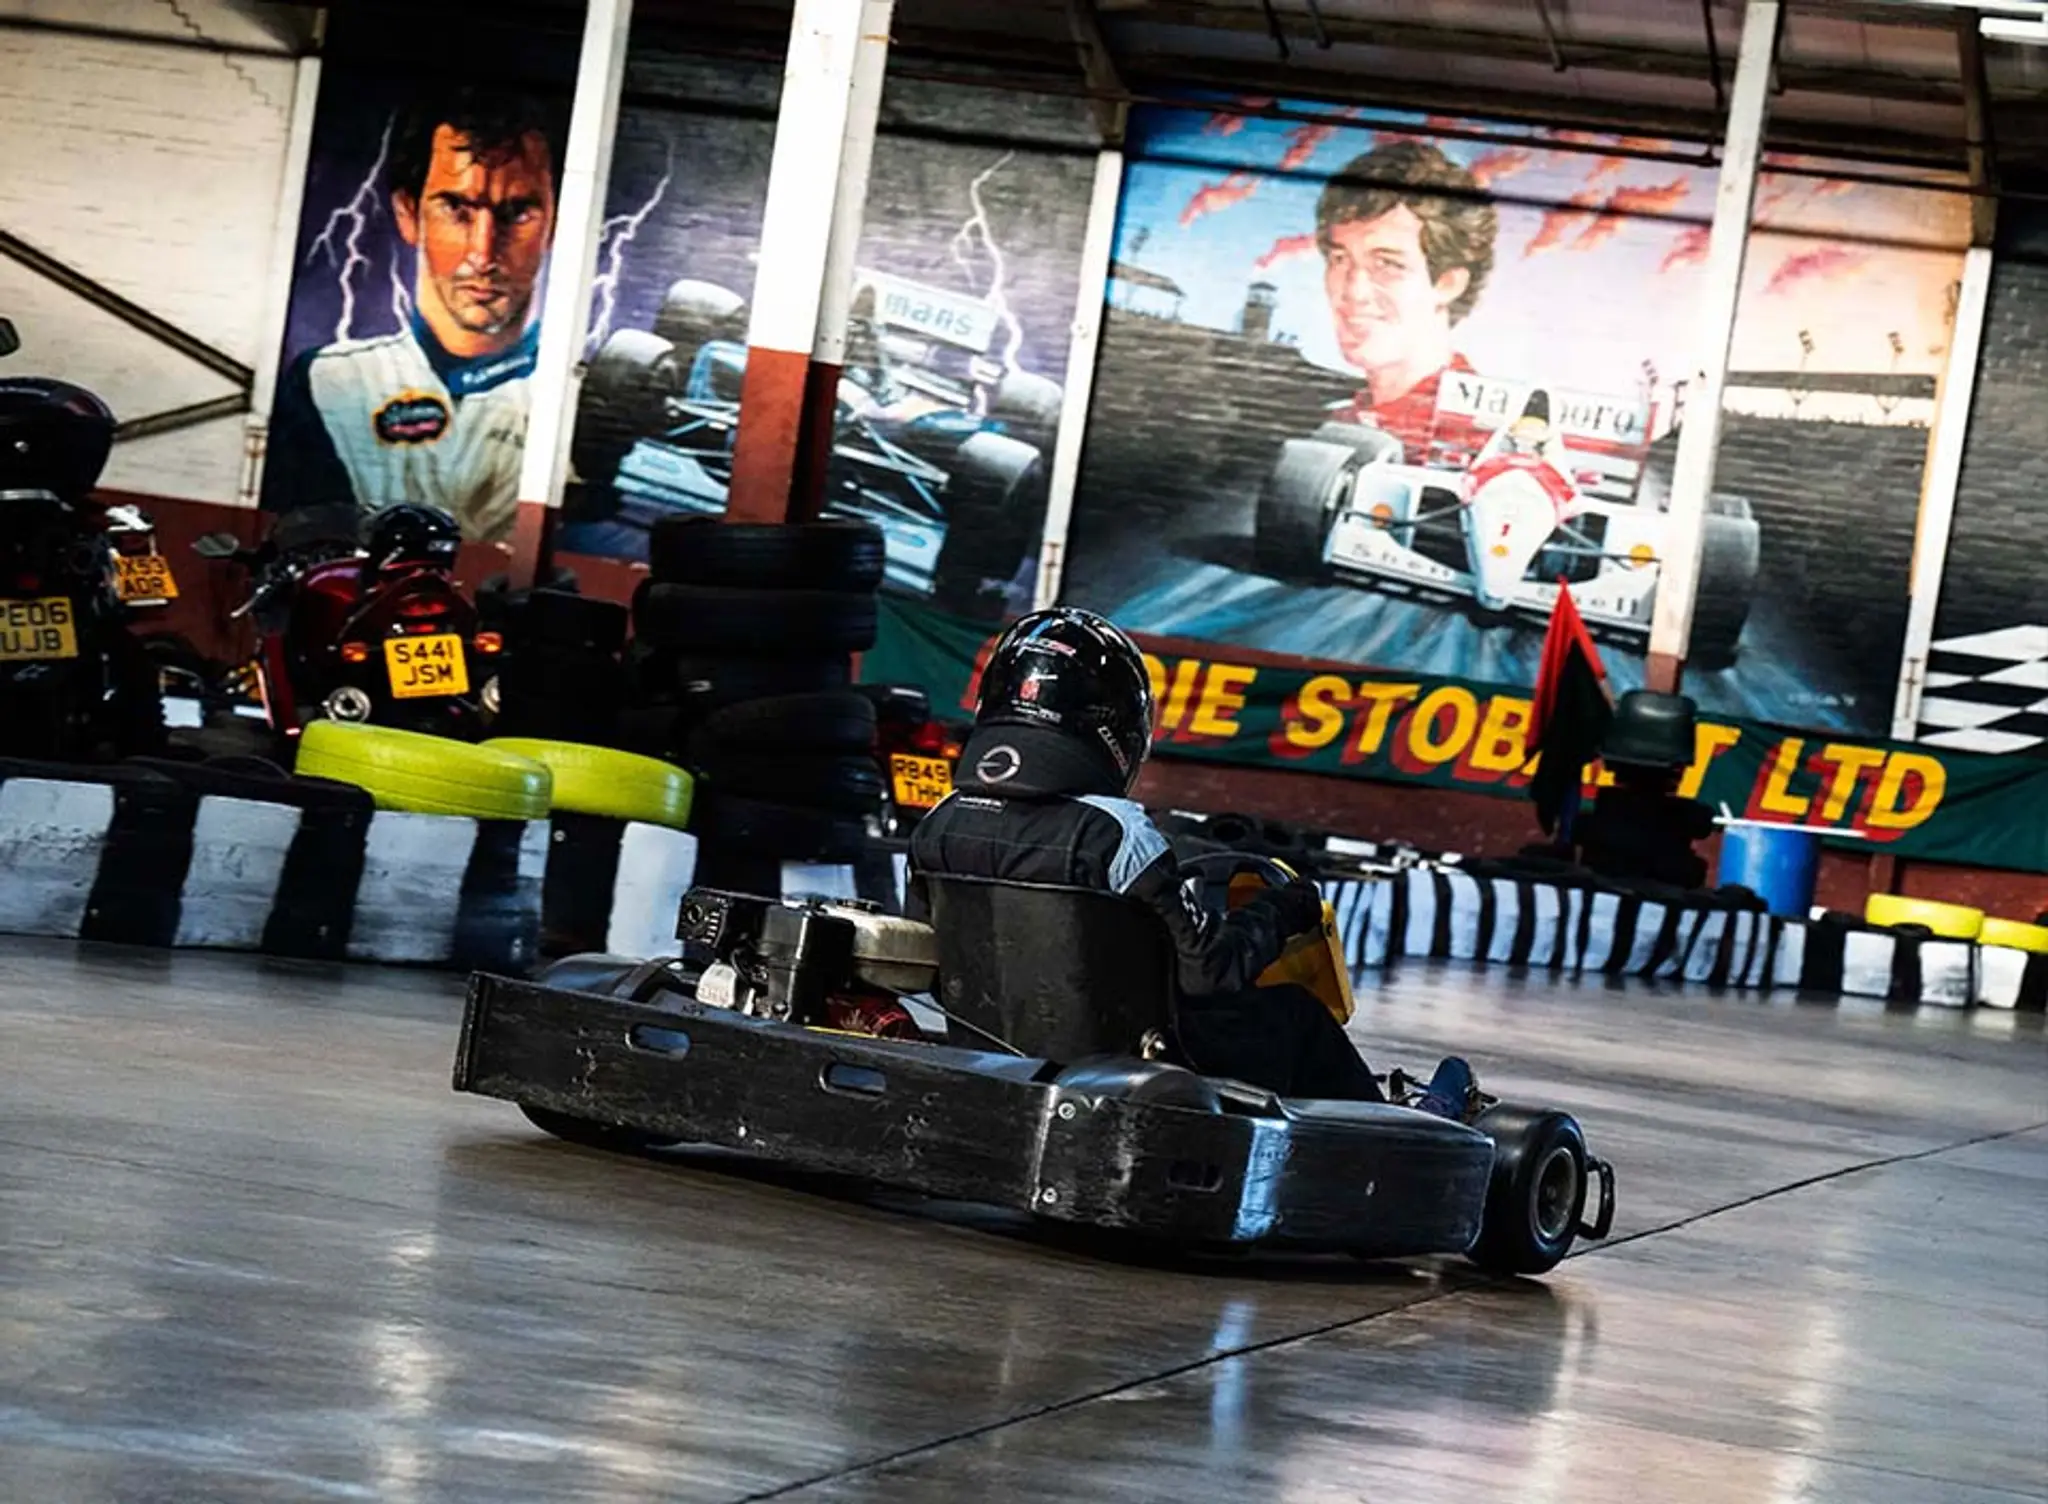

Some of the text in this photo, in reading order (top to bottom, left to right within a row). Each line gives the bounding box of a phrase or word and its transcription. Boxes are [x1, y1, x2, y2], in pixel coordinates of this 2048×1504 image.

[1457, 381, 1635, 435] Maoro
[0, 629, 63, 653] UJB
[394, 640, 455, 664] S441
[402, 663, 454, 687] JSM
[1286, 675, 1741, 800] STOBT
[1760, 736, 1947, 830] LTD
[894, 758, 949, 784] R849
